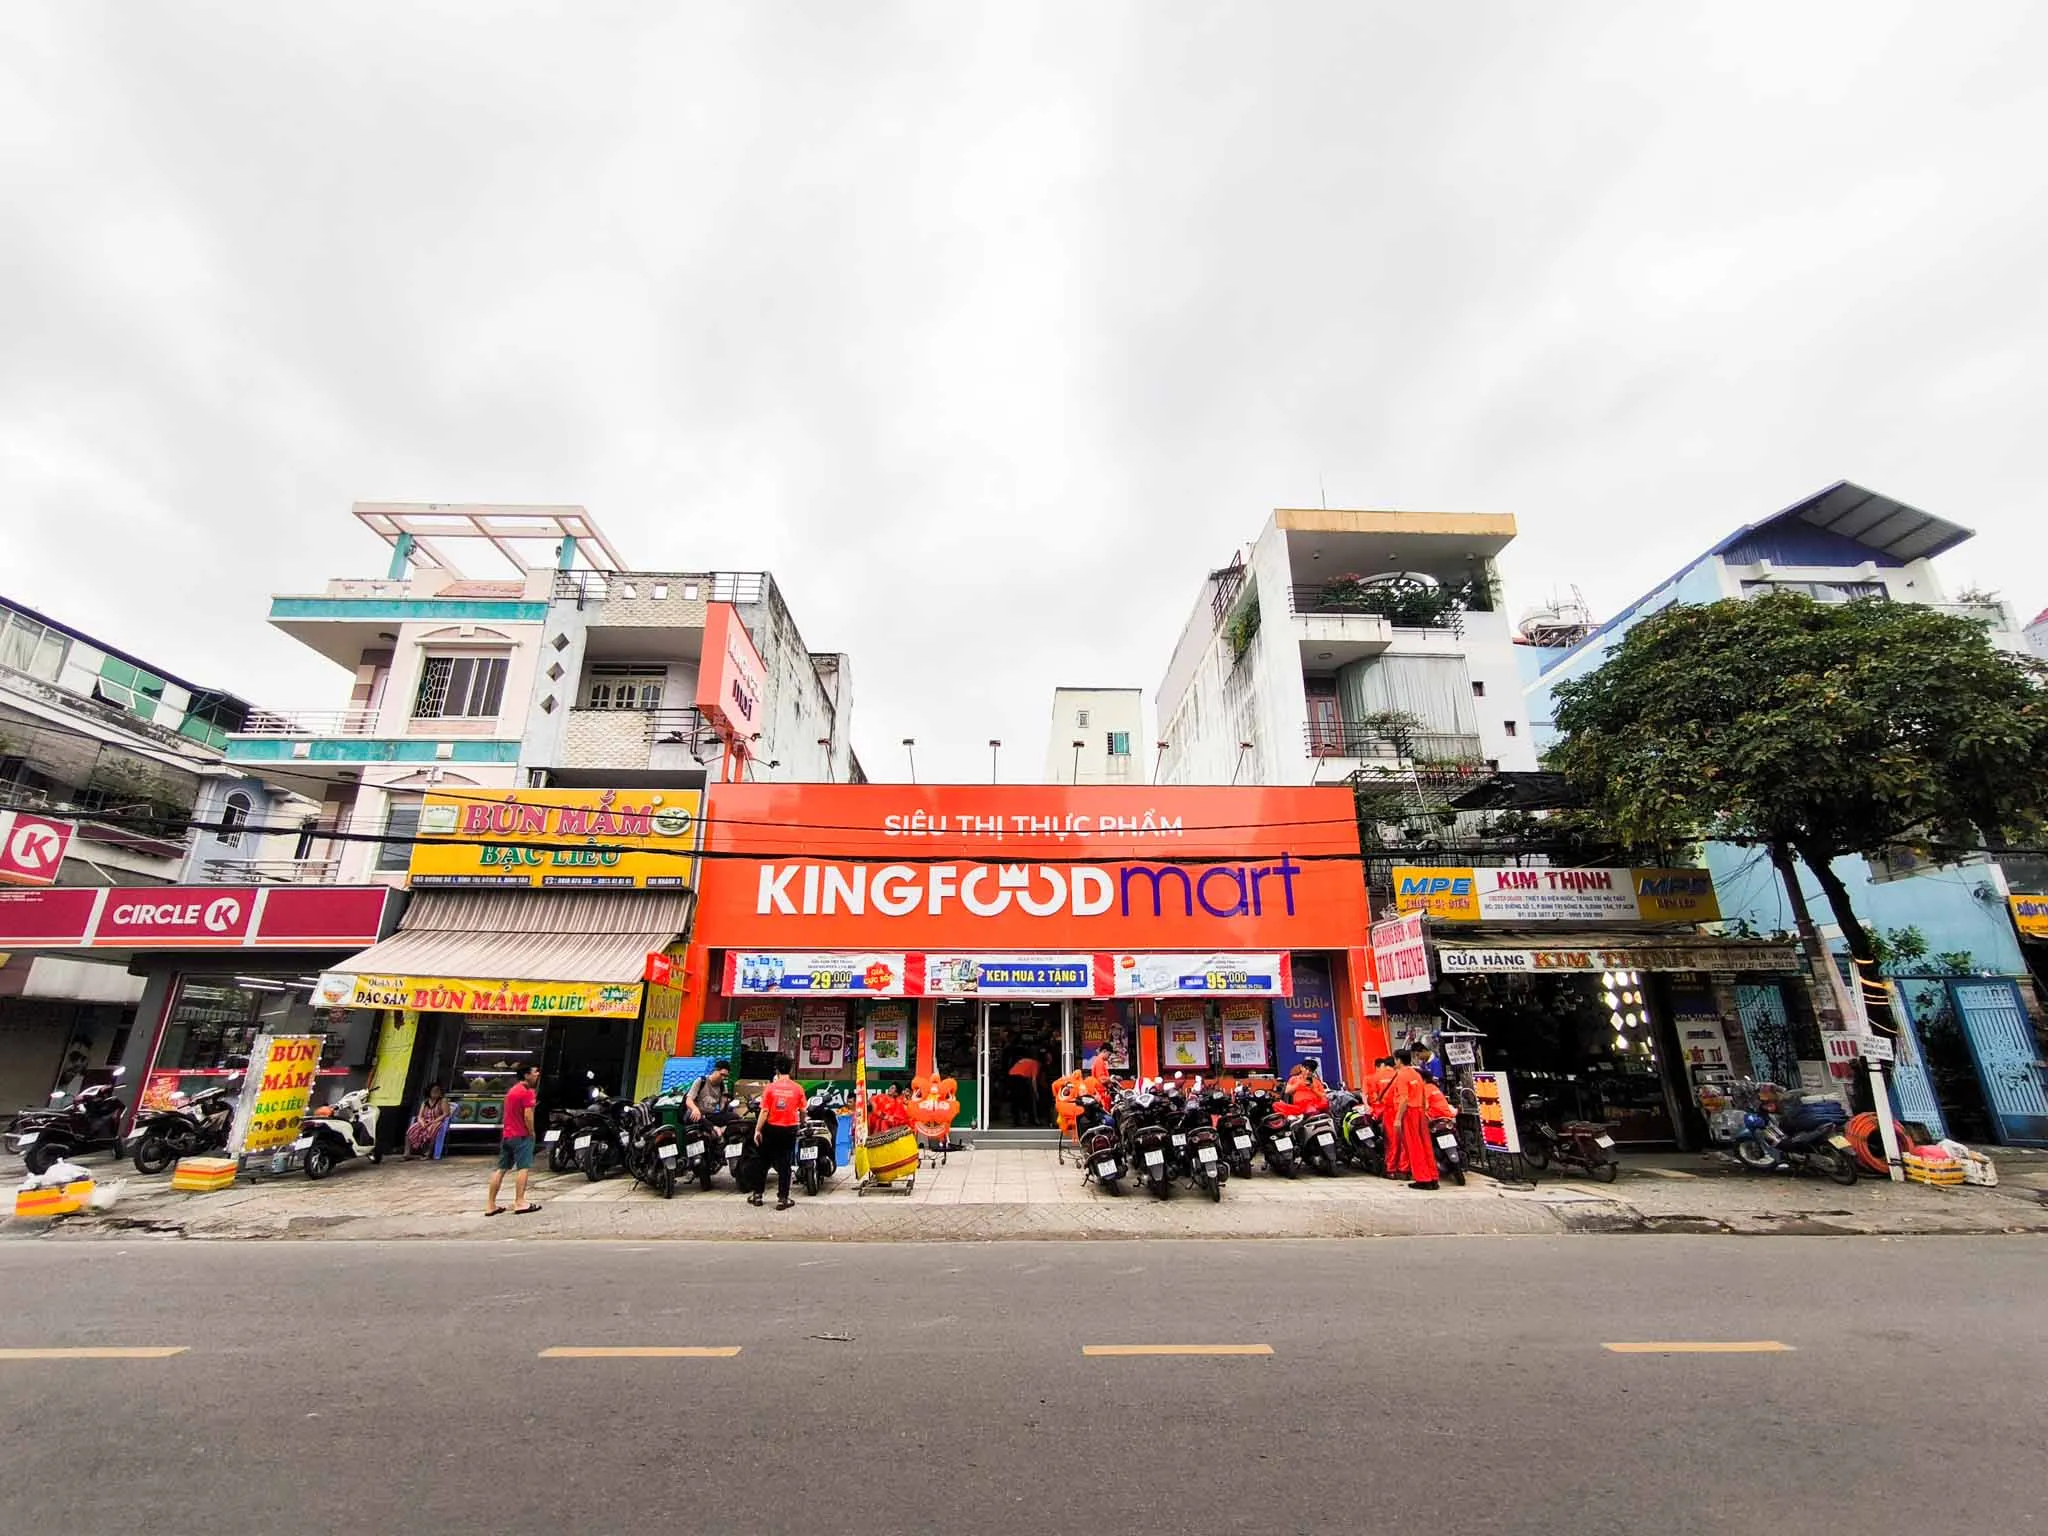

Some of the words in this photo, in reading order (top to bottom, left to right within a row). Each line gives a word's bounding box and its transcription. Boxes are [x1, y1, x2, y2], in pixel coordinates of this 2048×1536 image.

[463, 795, 552, 834] BÚN
[884, 809, 947, 836] SIÊU
[955, 815, 1002, 841] THỊ
[1012, 811, 1091, 842] THỰC
[1100, 808, 1183, 837] PHẨM
[16, 827, 57, 869] K
[1400, 878, 1473, 896] MPE
[1496, 871, 1539, 890] KIM
[1544, 872, 1612, 893] THỊNH
[113, 904, 201, 924] CIRCLE
[209, 901, 238, 930] K
[1447, 951, 1477, 966] CỬA
[1484, 952, 1525, 966] HÀNG
[1534, 952, 1588, 968] KIM
[986, 970, 1009, 982] KEM
[1012, 970, 1035, 982] MUA
[1038, 970, 1045, 982] 2
[1049, 967, 1076, 985] TẶNG
[1080, 970, 1085, 982] 1
[411, 984, 466, 1010] BÚN
[532, 995, 556, 1012] BẠC
[816, 1024, 843, 1032] 30%
[272, 1041, 316, 1061] BÚN
